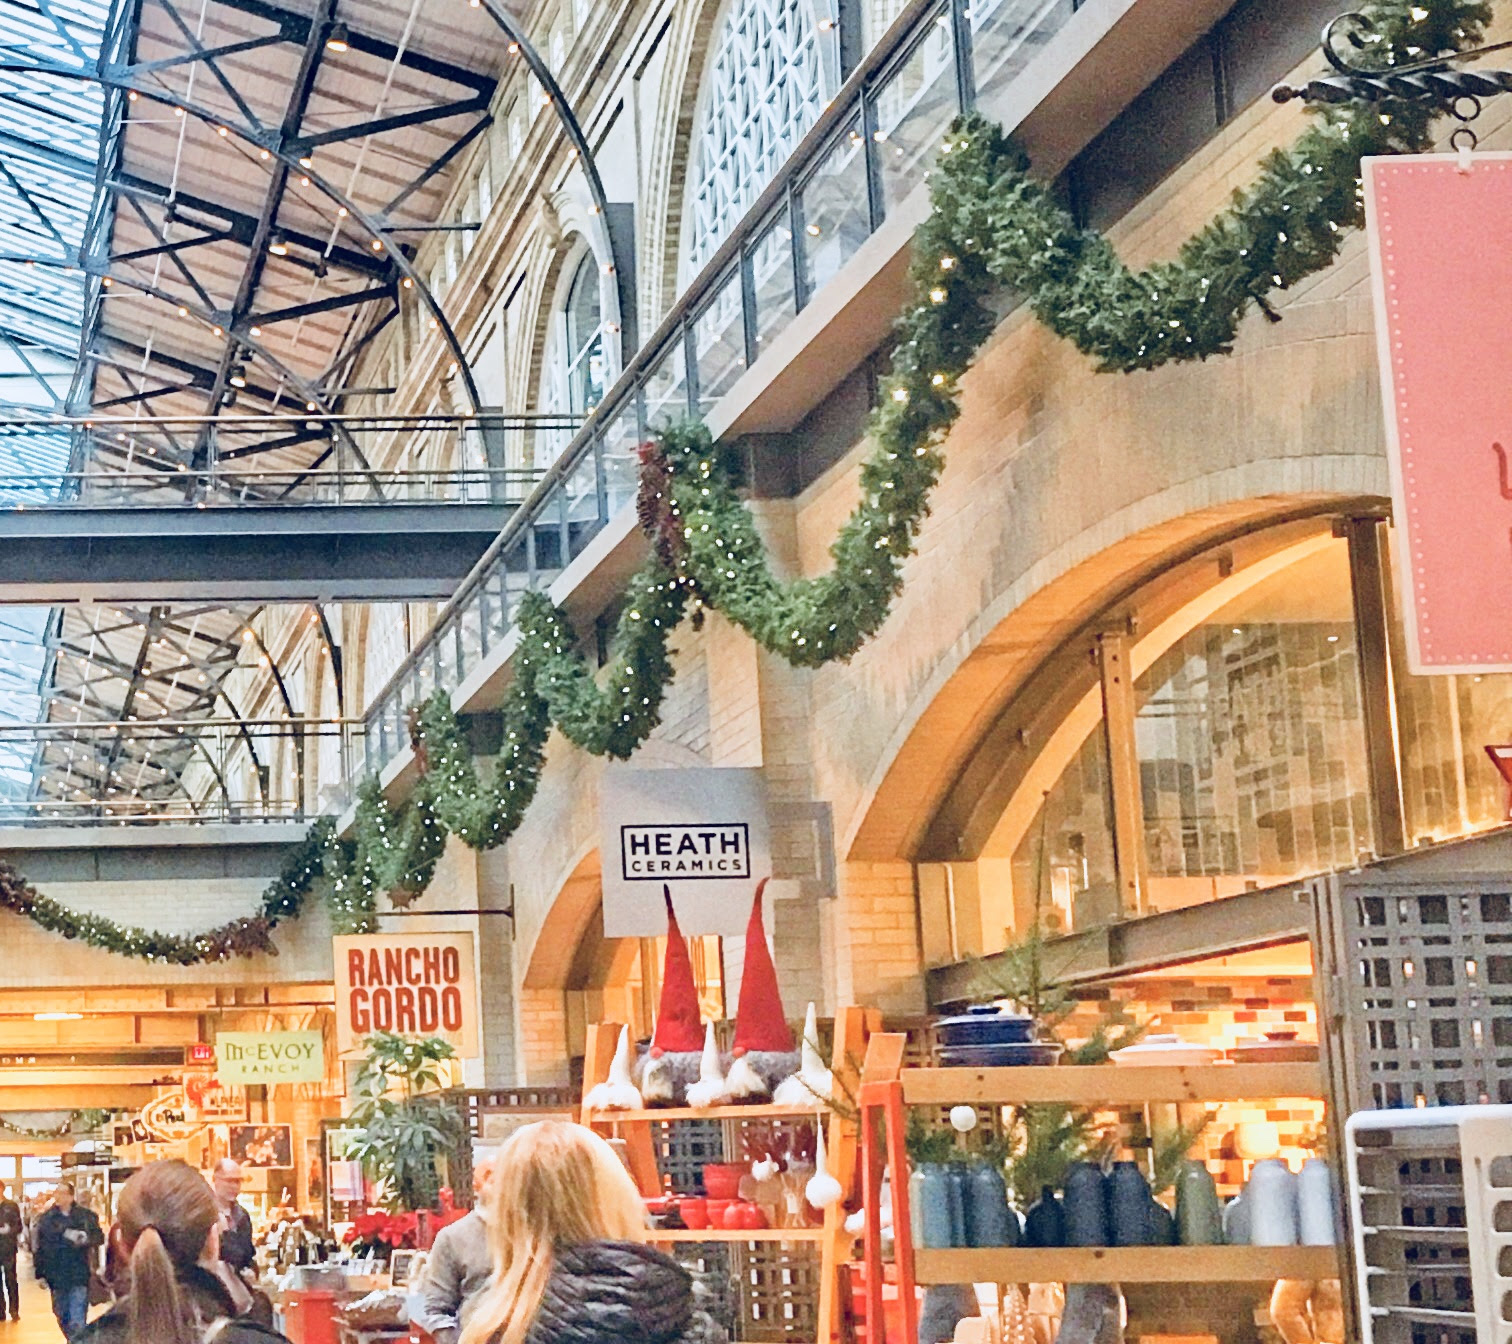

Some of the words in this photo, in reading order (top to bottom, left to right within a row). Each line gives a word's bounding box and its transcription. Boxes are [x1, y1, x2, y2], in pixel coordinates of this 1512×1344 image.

[630, 832, 740, 855] HEATH
[631, 859, 742, 872] CERAMICS
[348, 946, 460, 987] RANCHO
[350, 986, 462, 1034] GORDO
[241, 1064, 300, 1074] RANCH
